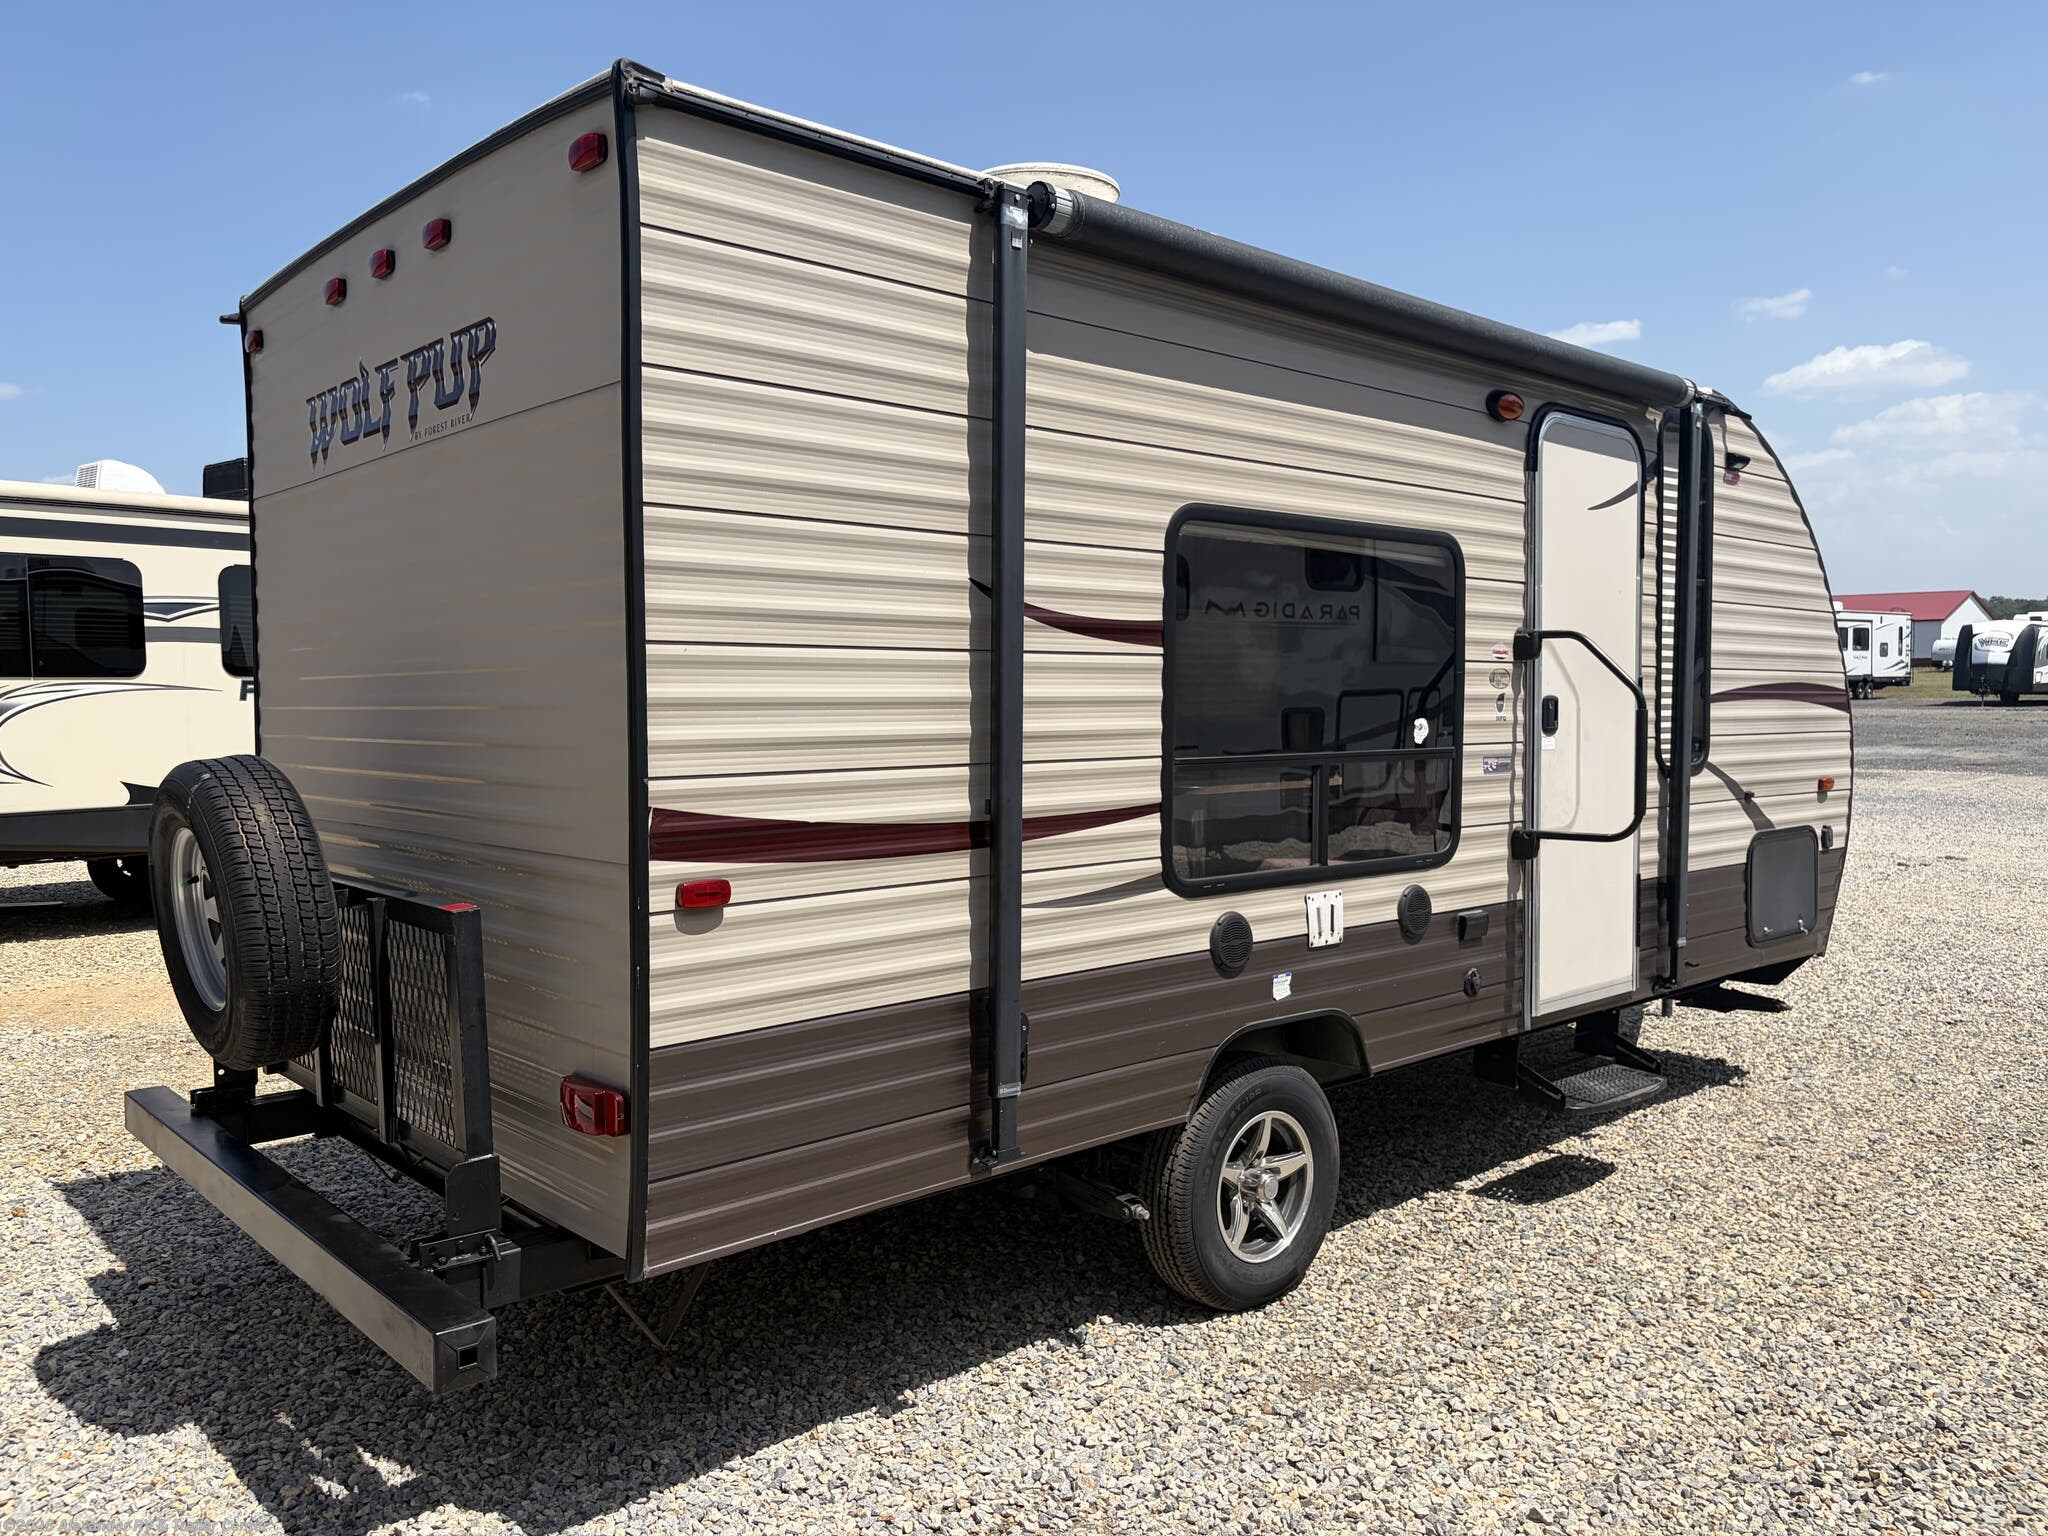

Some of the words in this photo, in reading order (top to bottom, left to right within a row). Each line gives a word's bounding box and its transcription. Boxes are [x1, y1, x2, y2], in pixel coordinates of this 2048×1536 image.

[306, 356, 399, 474] WOLF
[400, 316, 496, 442] PUP
[414, 431, 422, 441] BY
[424, 420, 448, 437] FOREST
[450, 413, 472, 428] RIVER
